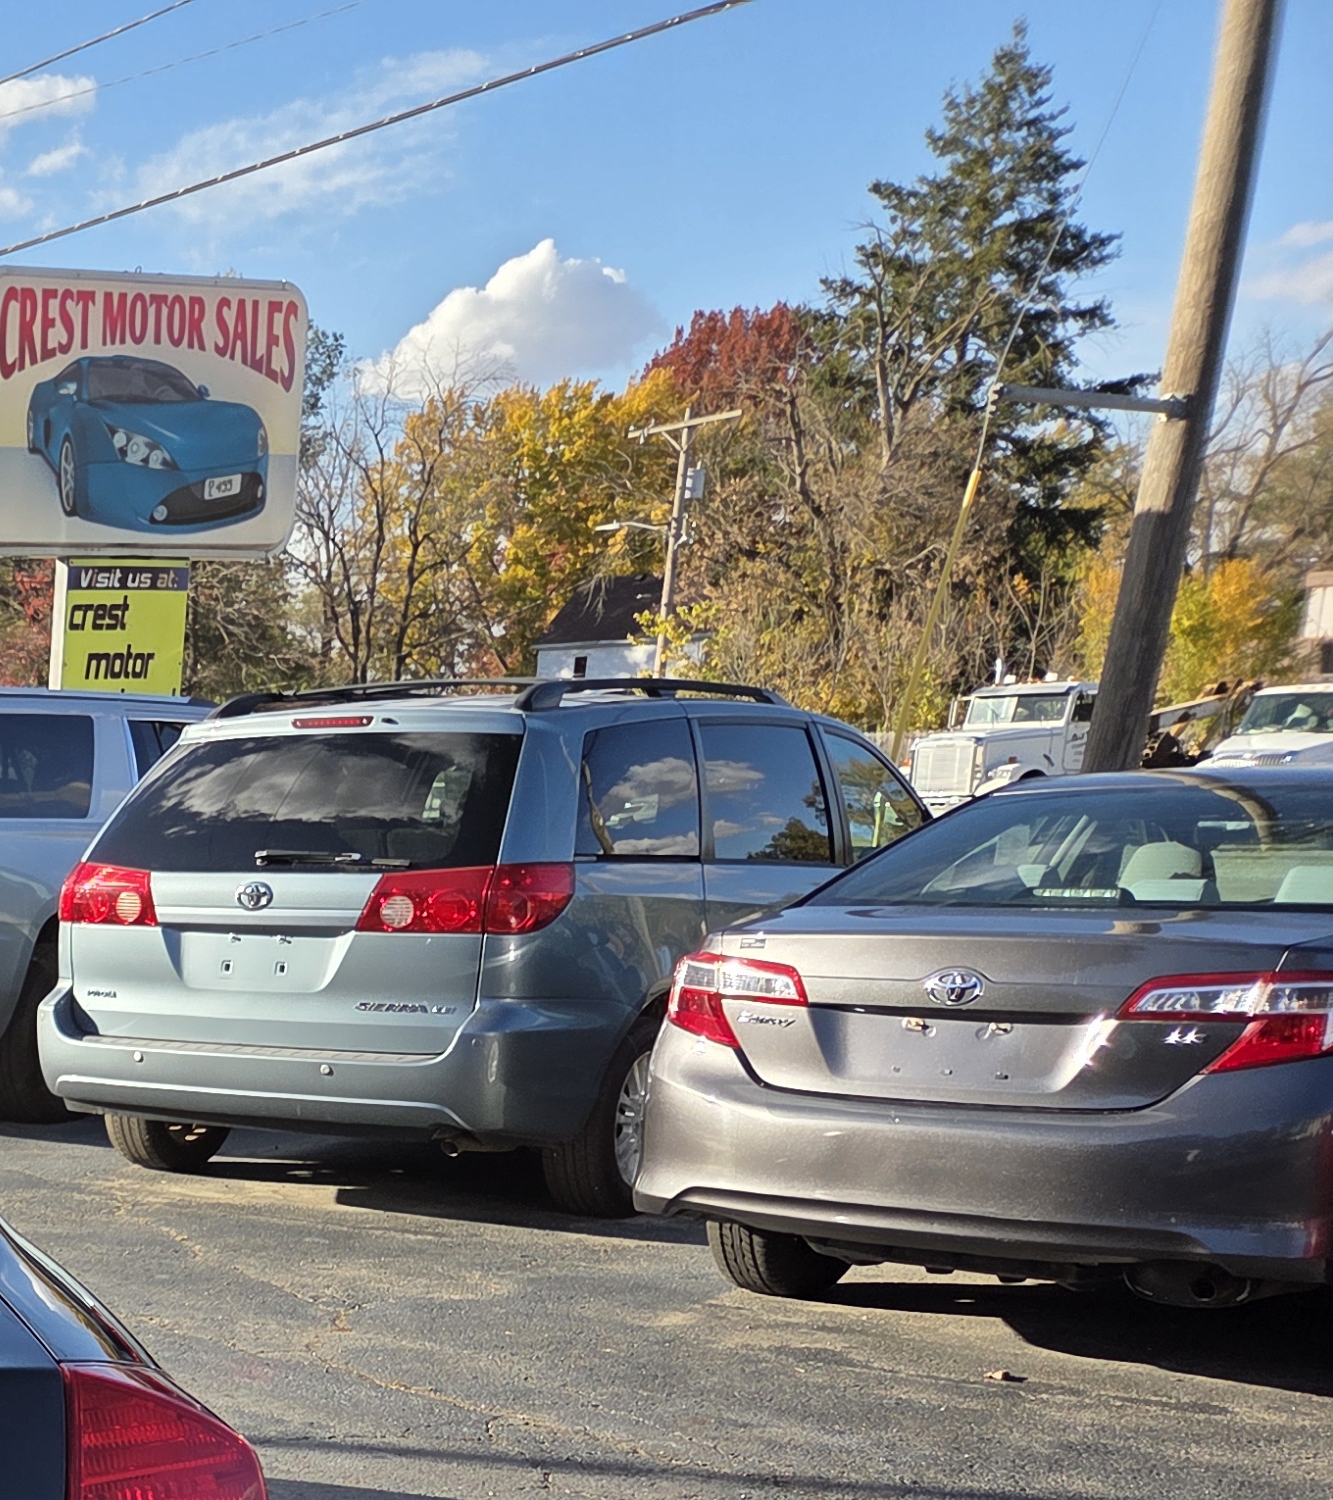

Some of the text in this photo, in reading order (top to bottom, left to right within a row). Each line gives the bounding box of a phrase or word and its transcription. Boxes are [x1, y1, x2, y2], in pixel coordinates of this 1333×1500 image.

[102, 291, 207, 352] MOTOR
[214, 296, 299, 393] SALES
[80, 568, 178, 588] Visit us at:
[68, 595, 129, 631] crest
[85, 644, 155, 680] motor
